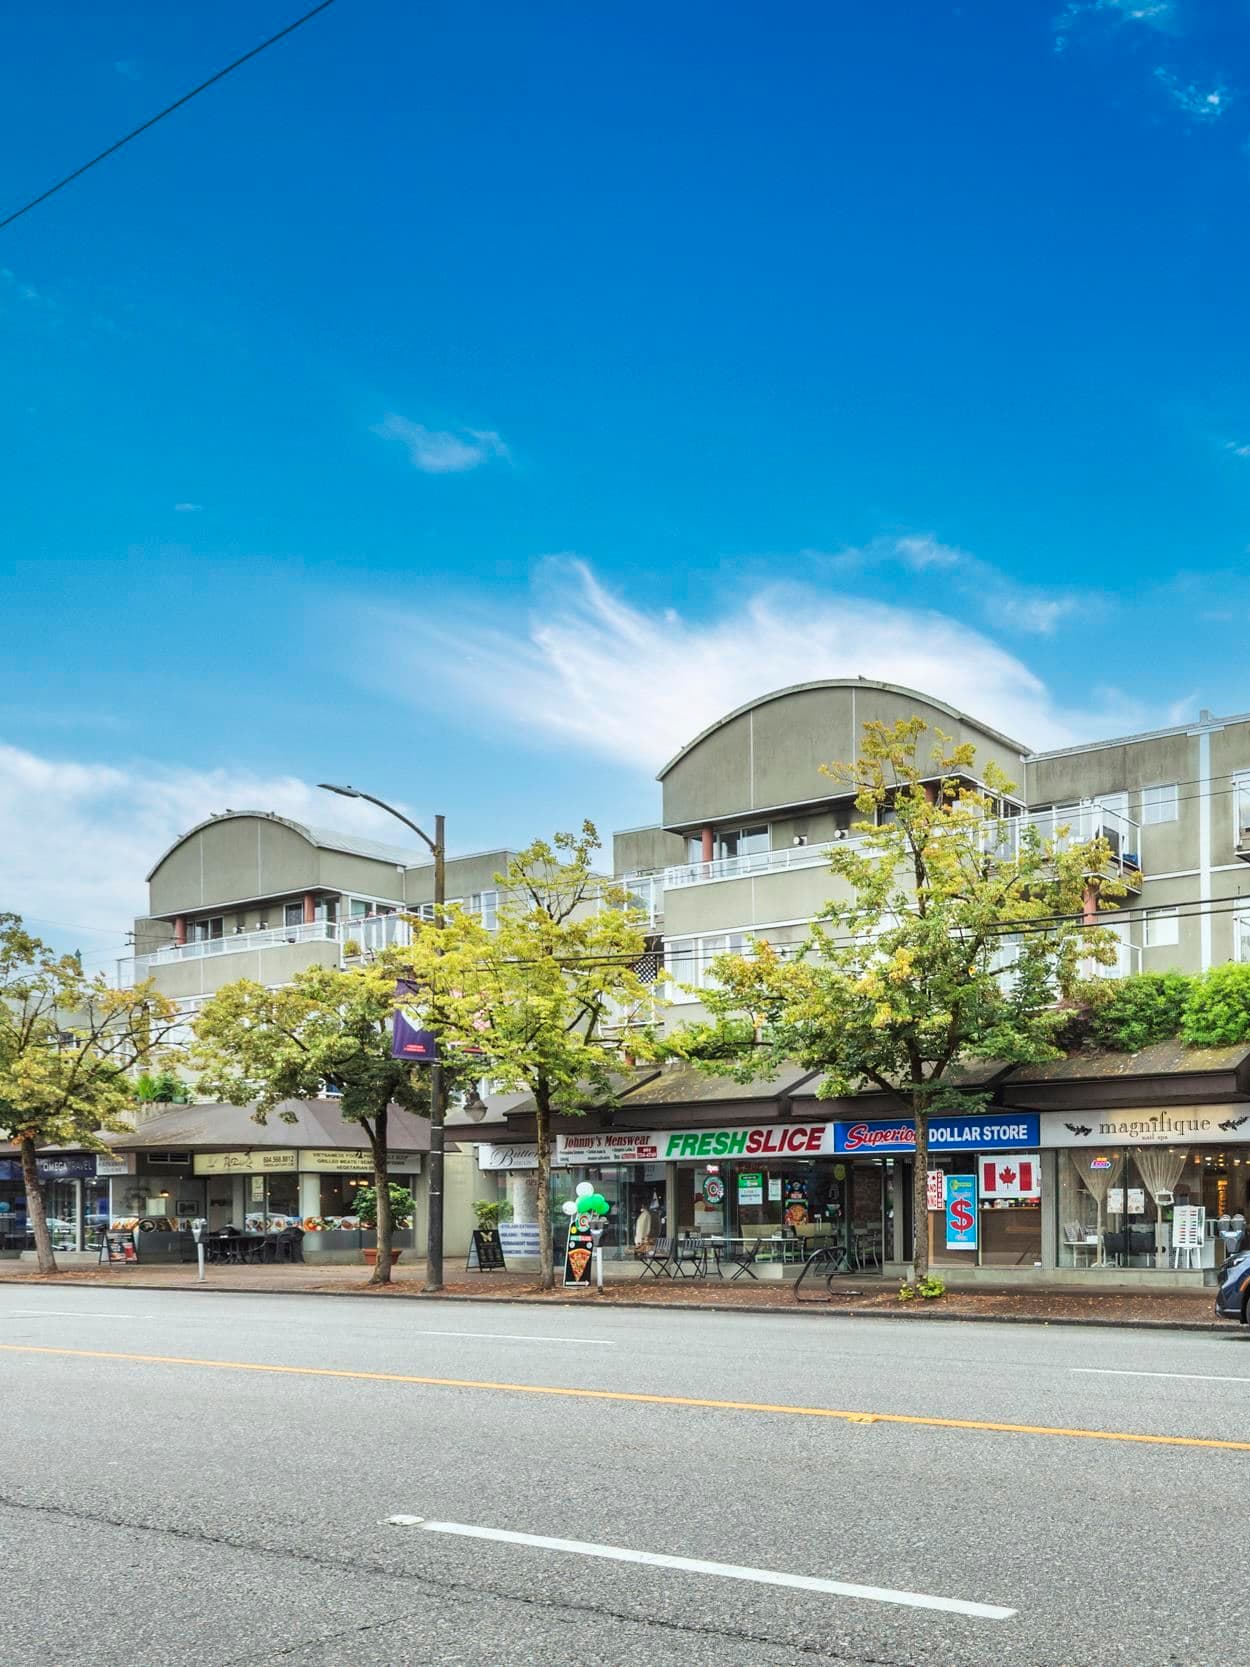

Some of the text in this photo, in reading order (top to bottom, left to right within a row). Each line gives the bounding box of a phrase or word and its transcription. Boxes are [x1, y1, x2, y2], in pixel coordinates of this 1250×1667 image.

[1098, 1111, 1211, 1137] magnifique
[564, 1135, 651, 1148] Johnny's Menswear
[845, 1124, 1028, 1149] Superio DOLLAR STORE
[43, 1161, 67, 1172] OMEGA
